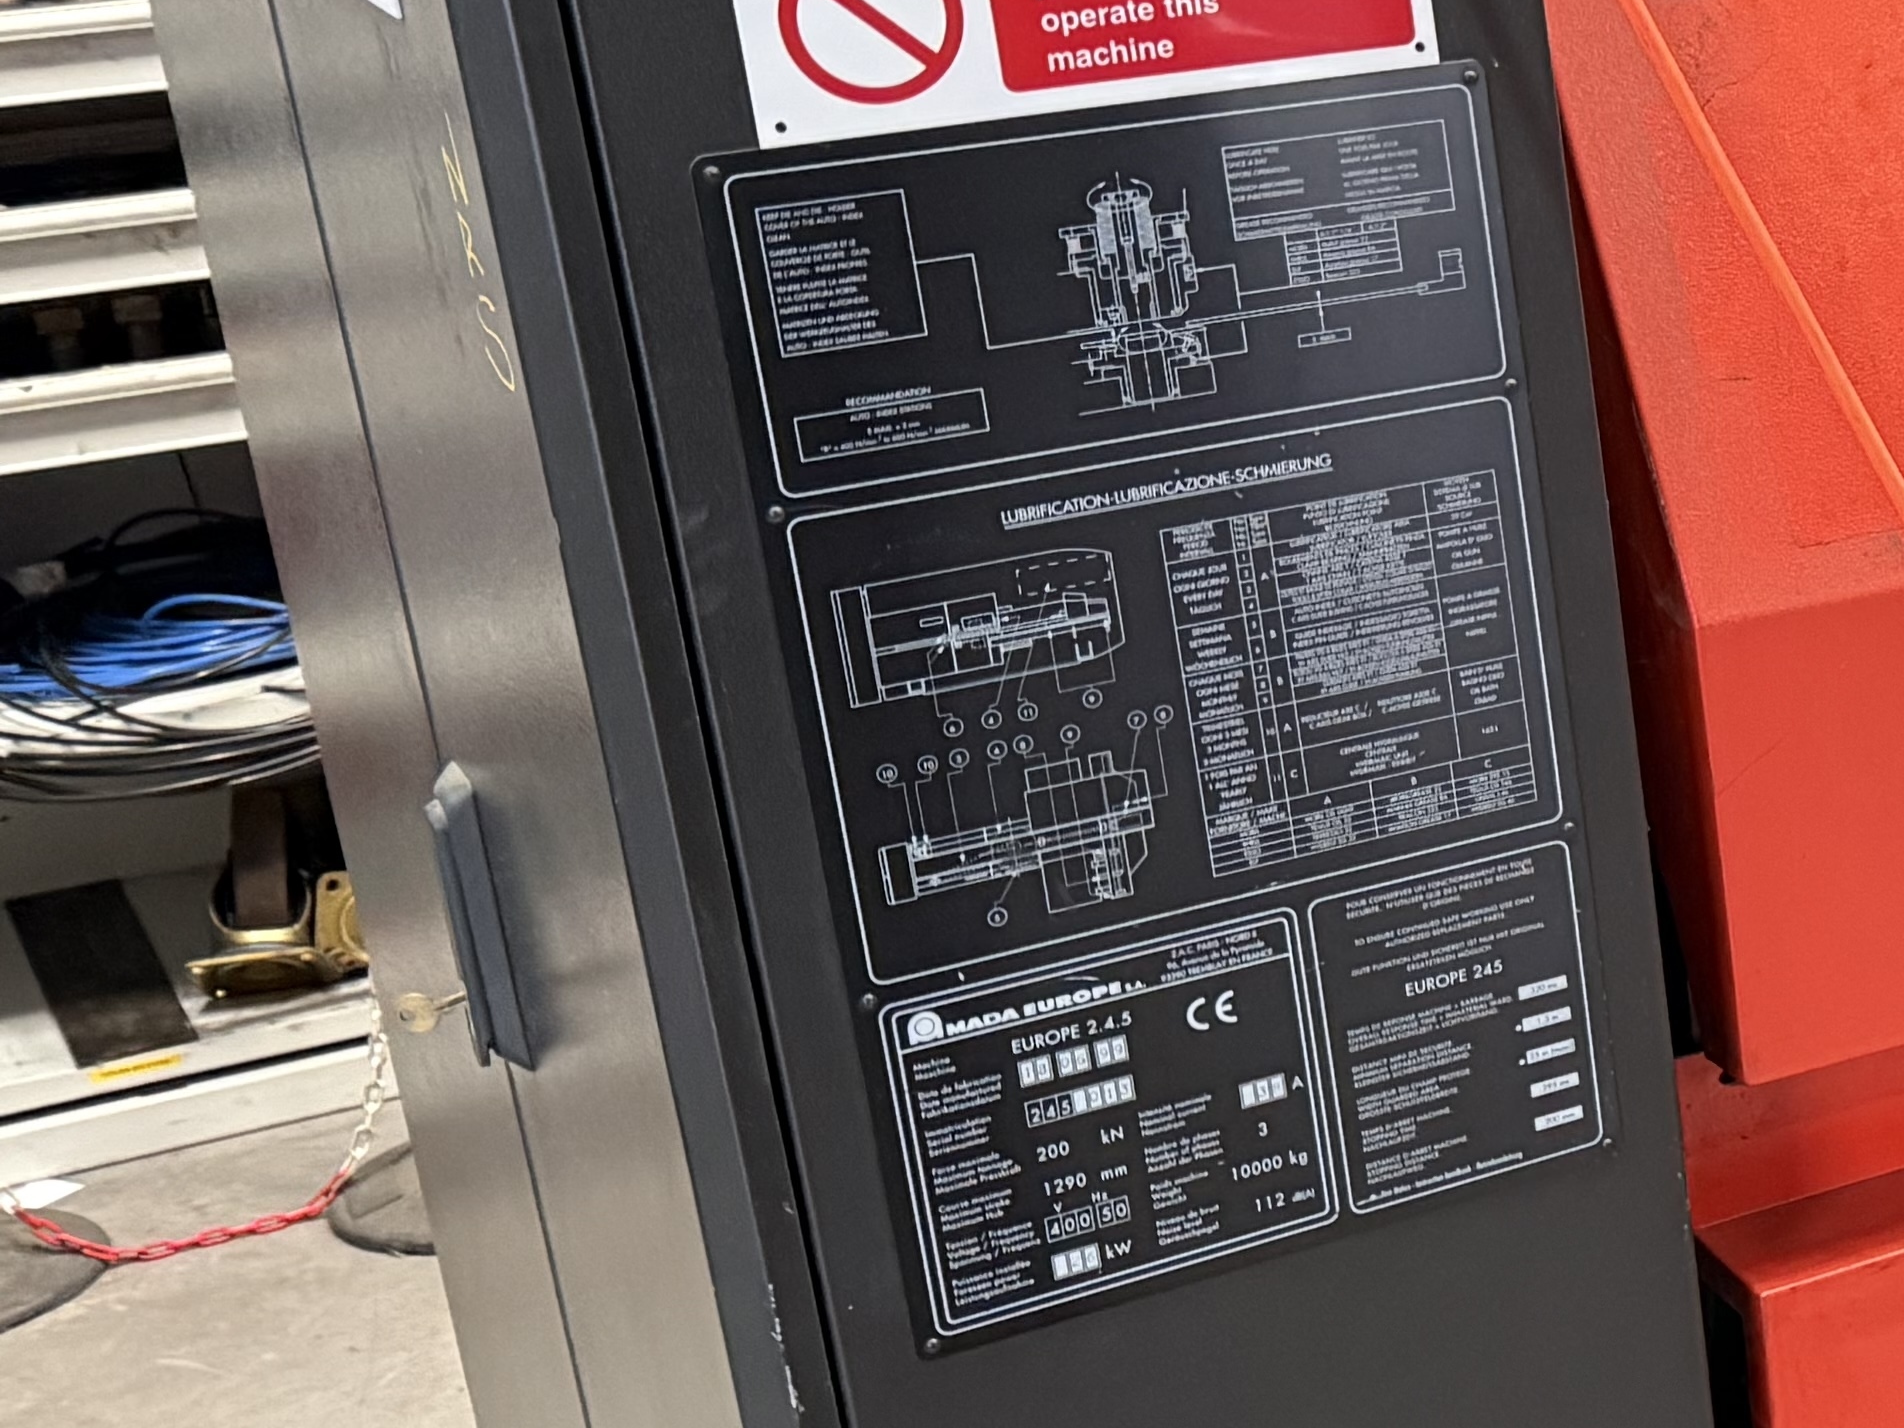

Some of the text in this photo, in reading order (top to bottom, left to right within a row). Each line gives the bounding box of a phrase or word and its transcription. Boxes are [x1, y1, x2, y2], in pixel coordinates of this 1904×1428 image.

[1041, 0, 1154, 37] operate
[1047, 38, 1174, 72] machine
[1405, 958, 1502, 997] EUROPE 245
[1023, 980, 1121, 1018] EUROPE
[1011, 1010, 1132, 1055] EUROPE 2.4.5
[1292, 1075, 1303, 1089] A
[1036, 1125, 1123, 1162] 200 kN
[1258, 1121, 1267, 1137] 3
[1044, 1164, 1127, 1196] 1290 mm
[1232, 1147, 1307, 1181] 10000 kg
[1053, 1202, 1062, 1213] V
[1255, 1191, 1285, 1212] 112
[1050, 1203, 1126, 1236] 400 50
[1104, 1239, 1131, 1259] kW
